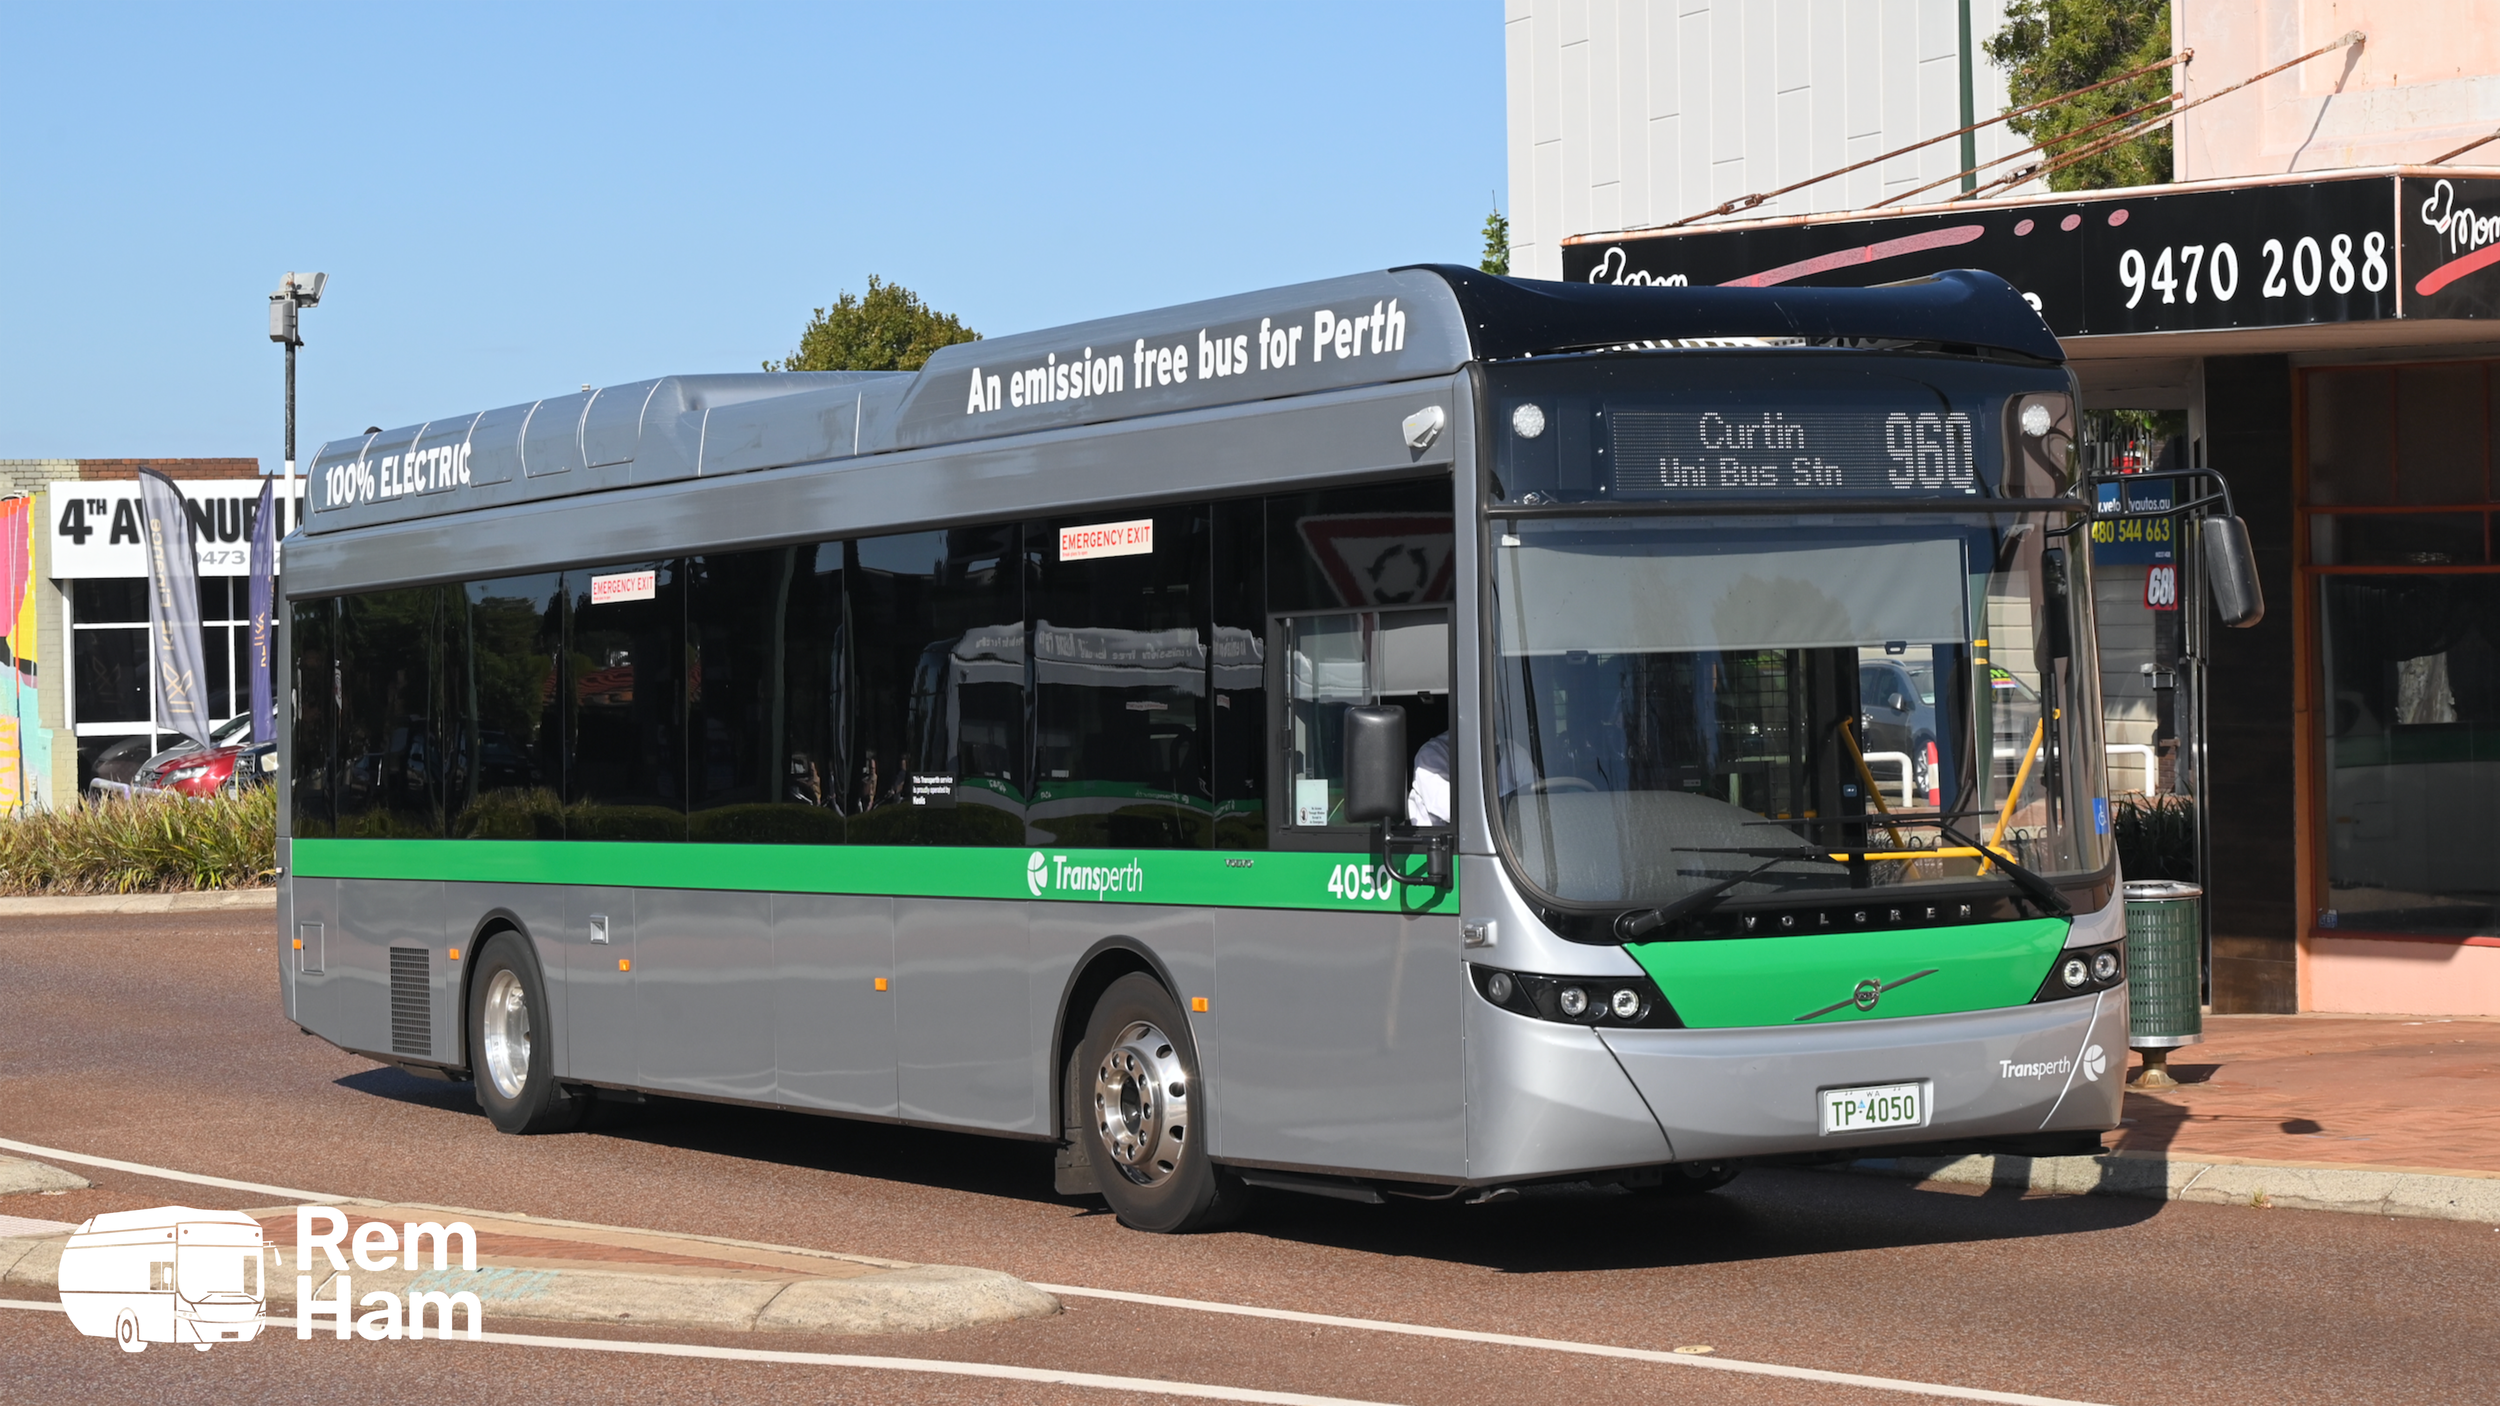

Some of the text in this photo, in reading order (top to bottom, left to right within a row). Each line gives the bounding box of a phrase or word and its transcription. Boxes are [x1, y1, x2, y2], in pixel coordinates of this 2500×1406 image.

[2118, 231, 2389, 310] 9470 2088
[966, 297, 1406, 415] An emission free bus for Perth
[1699, 412, 1805, 450] Curtin
[1885, 411, 1974, 490] 960
[325, 441, 472, 507] 100% ELECTRIC
[1659, 457, 1843, 487] Uni Bus Stn
[58, 498, 107, 545] 4TH
[1062, 526, 1151, 551] EMERGENCY EXIT
[2118, 519, 2142, 542] 544
[2145, 518, 2170, 542] 663
[593, 575, 653, 596] EMERGENCY EXIT
[1053, 856, 1143, 901] Transperth
[1327, 863, 1393, 901] 4050
[1744, 903, 1972, 929] VOLGREN
[1999, 1055, 2071, 1081] Transperth
[1865, 1095, 1915, 1123] 4050
[1866, 1090, 1881, 1098] WA
